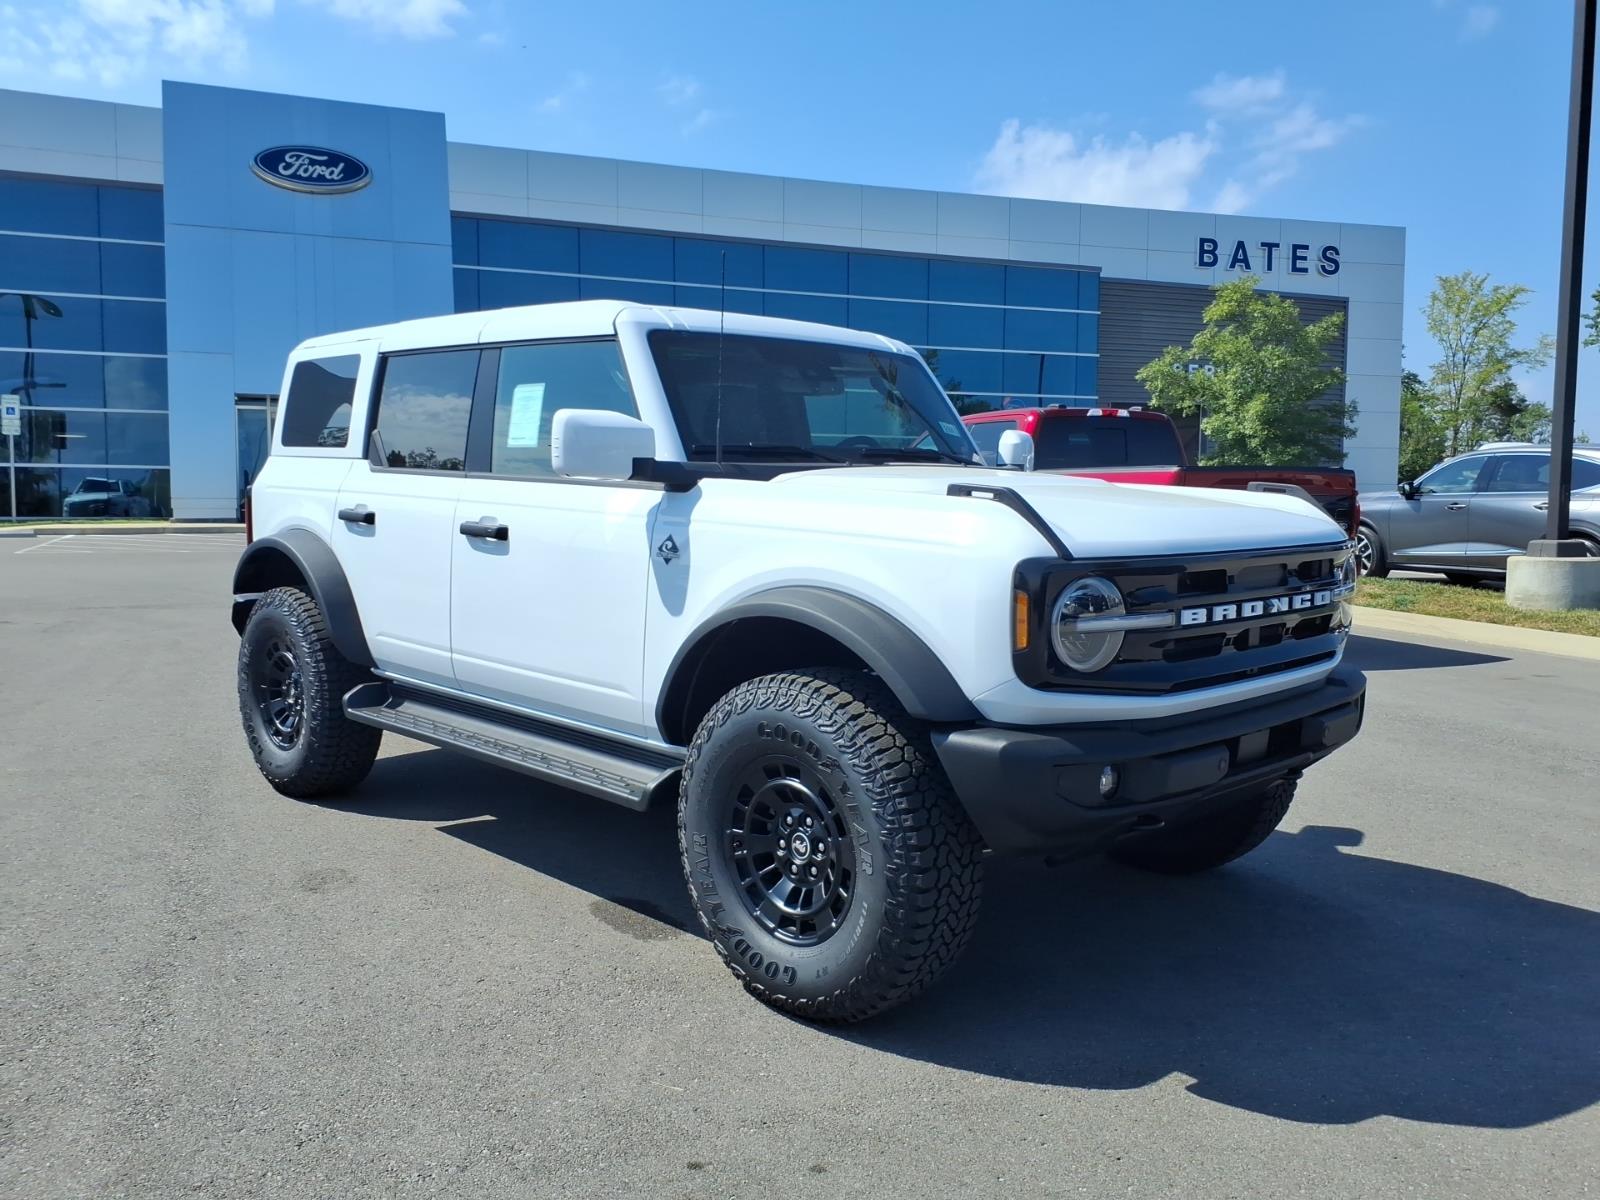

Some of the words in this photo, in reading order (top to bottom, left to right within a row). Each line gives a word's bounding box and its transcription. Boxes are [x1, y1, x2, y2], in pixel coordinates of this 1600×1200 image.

[278, 151, 345, 180] Ford
[1196, 236, 1341, 276] BATES
[1180, 590, 1331, 625] BRONCO
